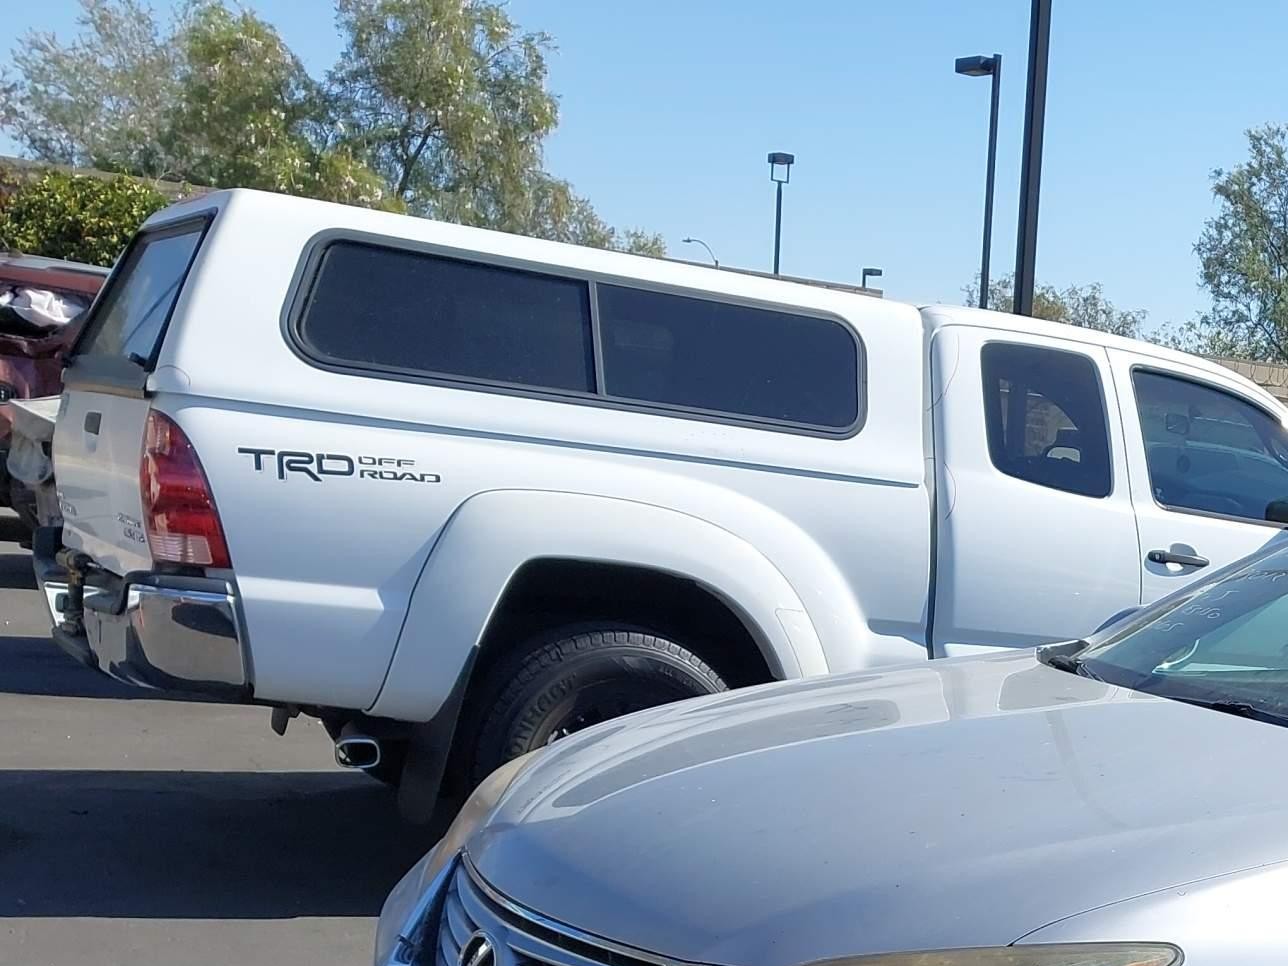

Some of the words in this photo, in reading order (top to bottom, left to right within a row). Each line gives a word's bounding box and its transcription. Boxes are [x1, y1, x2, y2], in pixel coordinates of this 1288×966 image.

[238, 447, 354, 482] TRD
[358, 456, 416, 468] OFF
[359, 469, 441, 483] ROAD
